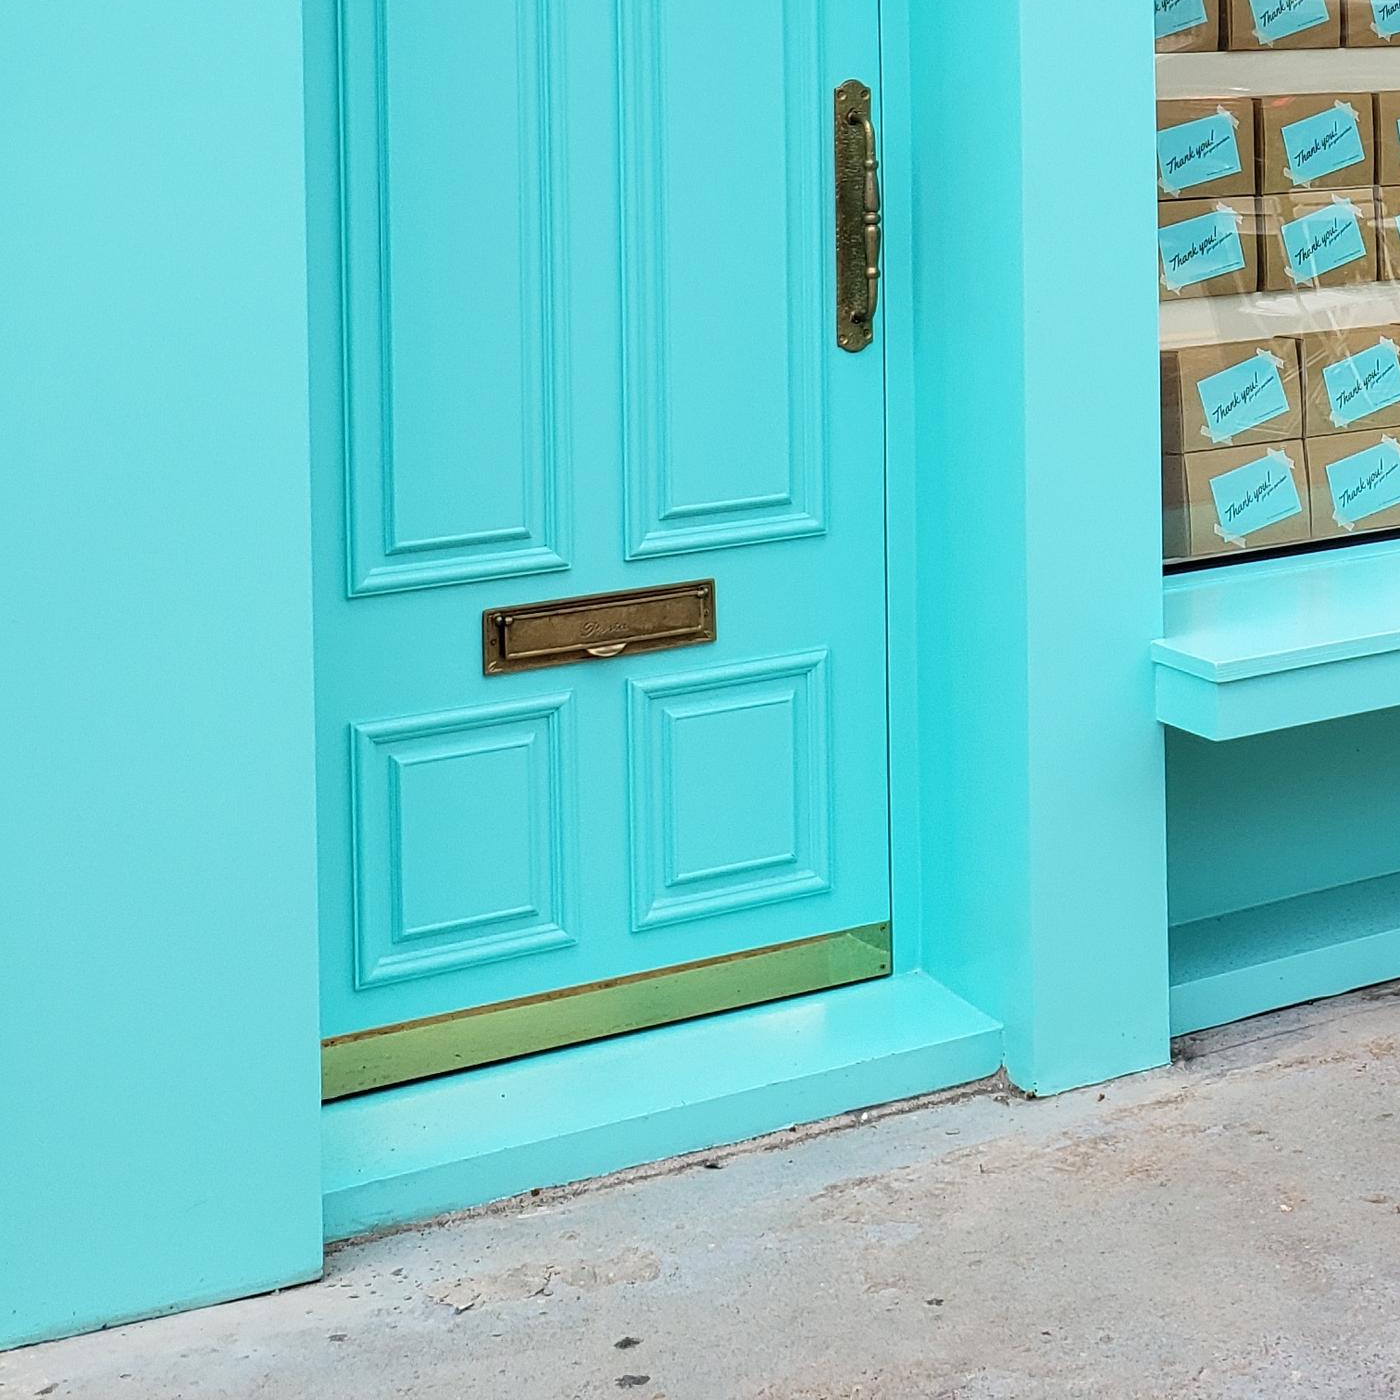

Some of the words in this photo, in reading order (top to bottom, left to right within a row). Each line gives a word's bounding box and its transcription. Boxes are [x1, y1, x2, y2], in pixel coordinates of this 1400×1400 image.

[1260, 0, 1286, 27] Thank
[1166, 146, 1196, 174] Thank
[1195, 129, 1214, 158] you!
[1294, 139, 1322, 166] Thank
[1321, 121, 1338, 150] you!
[1170, 242, 1200, 271] Thank
[1199, 225, 1216, 256] you!
[1295, 236, 1322, 265] Thank
[1321, 217, 1337, 247] you!
[1212, 392, 1240, 423] Thank
[1240, 371, 1258, 404] you!
[1335, 380, 1362, 409] Thank
[1363, 358, 1380, 390] you!
[1224, 490, 1253, 522] Thank
[1253, 470, 1271, 502] you!
[1339, 477, 1367, 508] Thank
[1367, 457, 1383, 490] you!
